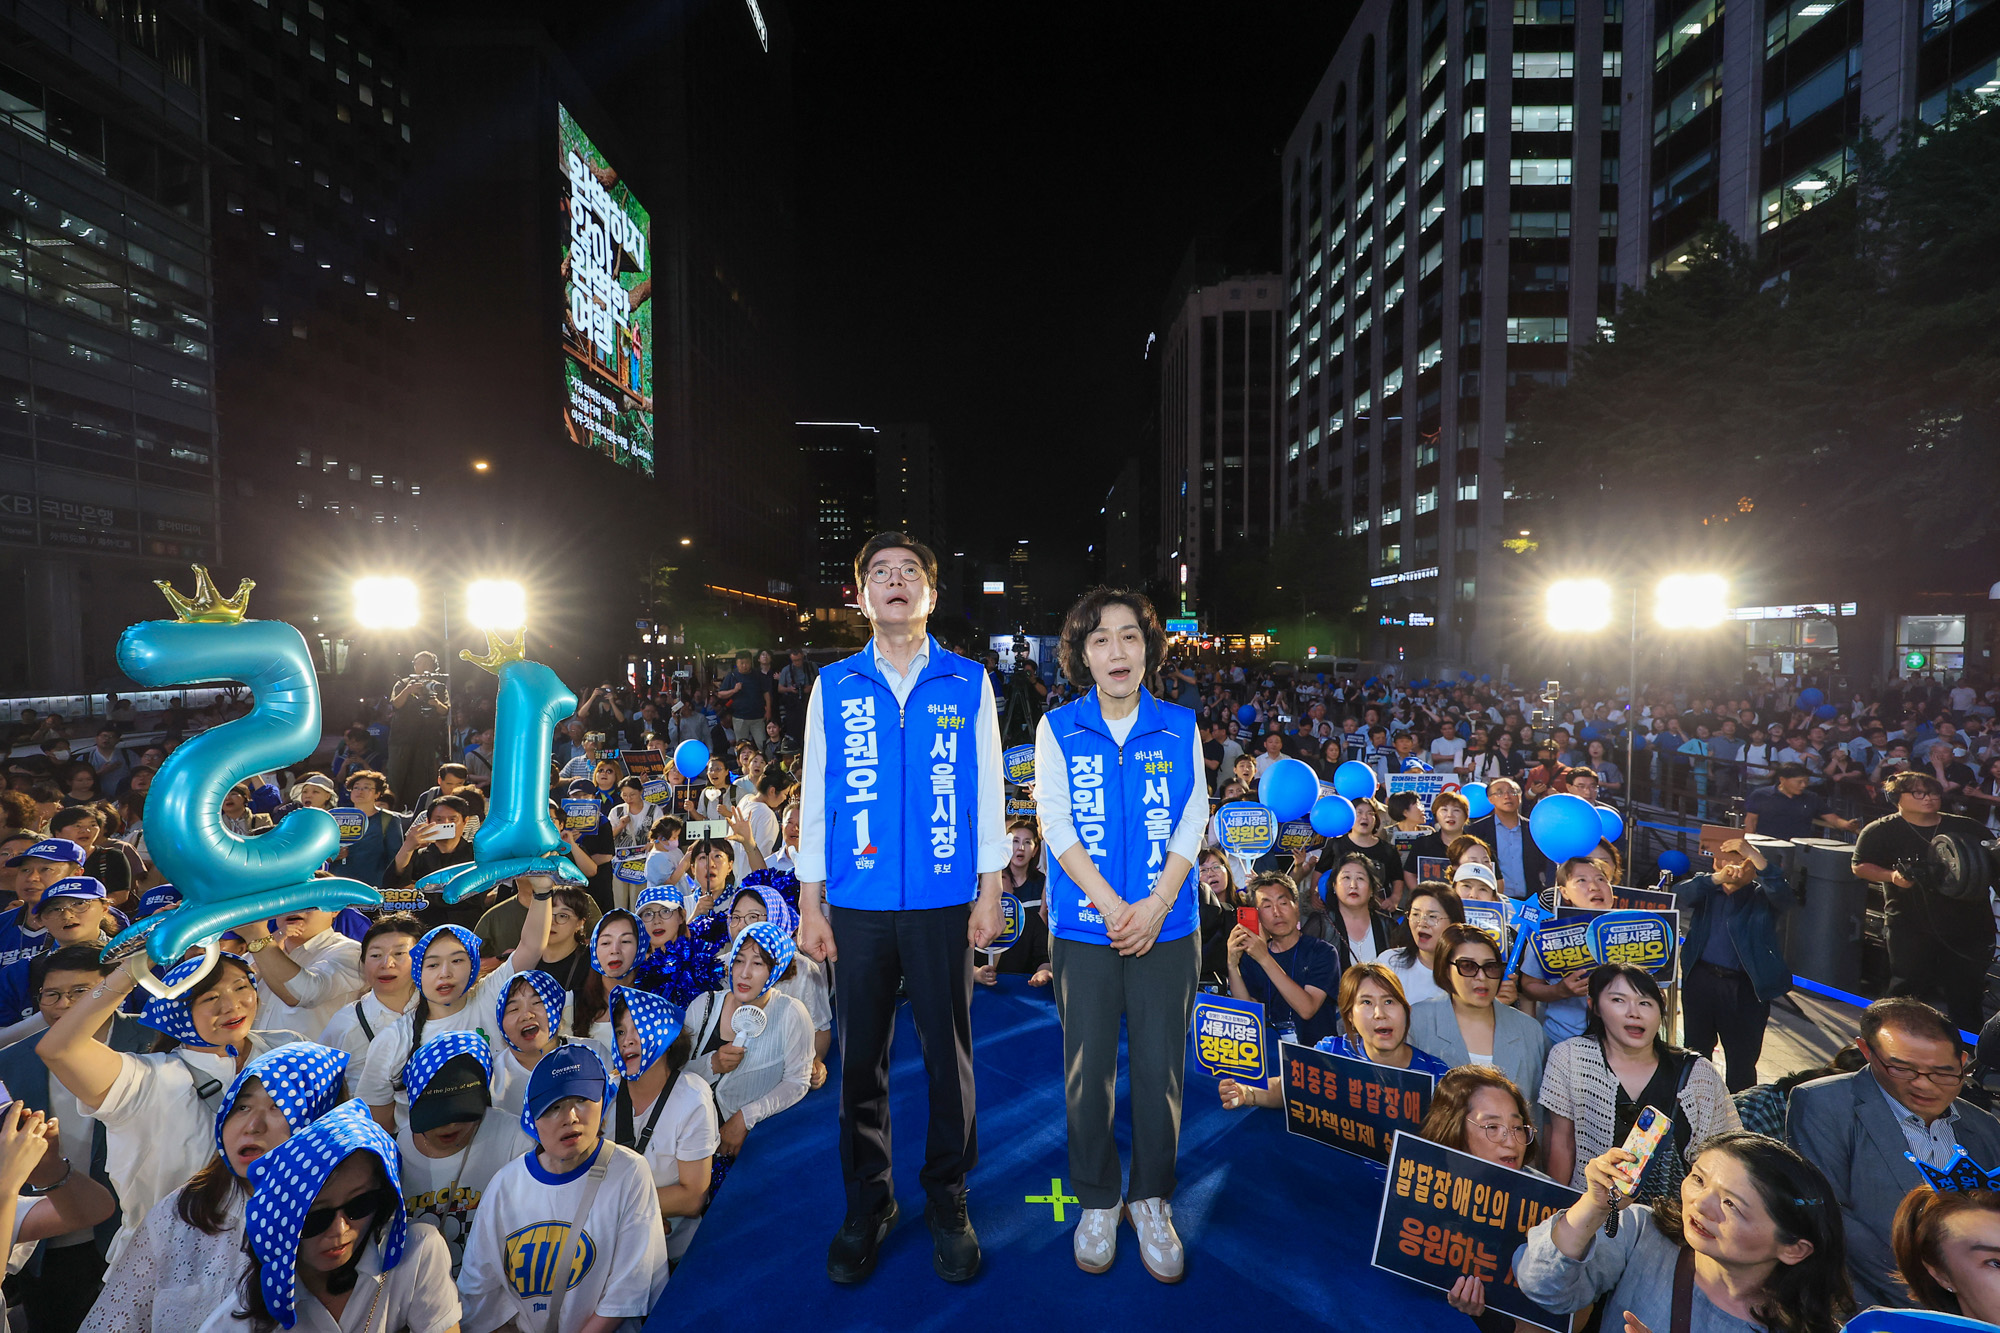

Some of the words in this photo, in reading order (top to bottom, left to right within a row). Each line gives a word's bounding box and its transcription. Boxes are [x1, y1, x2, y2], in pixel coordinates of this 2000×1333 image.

[568, 150, 645, 272] 완벽하지
[570, 196, 613, 276] 않아
[571, 241, 631, 329] 완벽한
[572, 287, 613, 355] 여행
[42, 500, 113, 526] 국민은행
[927, 704, 957, 715] 하나씩
[936, 716, 966, 730] 착착!
[841, 696, 878, 803] 정원오
[1134, 751, 1163, 761] 하나씩
[1144, 761, 1173, 775] 착착!
[929, 732, 957, 859] 서울시장
[1390, 782, 1442, 793] 행동하는
[1070, 754, 1107, 857] 정원오
[340, 825, 361, 836] 원오
[565, 816, 596, 828] 정원오
[1226, 816, 1267, 827] 서울시장은
[1225, 825, 1269, 843] 정원오
[855, 859, 875, 869] 민주당
[933, 863, 951, 875] 후보
[1078, 911, 1103, 924] 민주당
[1541, 933, 1588, 951] 서울시장
[1605, 929, 1662, 945] 서울시장은
[1605, 940, 1665, 963] 정원오
[1200, 1019, 1257, 1042] 서울시장은
[1200, 1035, 1260, 1068] 정원오
[1291, 1059, 1338, 1100] 최중증
[1348, 1077, 1420, 1124] 발달장애
[1290, 1099, 1375, 1149] 국가책임제
[1396, 1157, 1510, 1230] 발달장애인의
[1398, 1217, 1498, 1282] 응원하는
